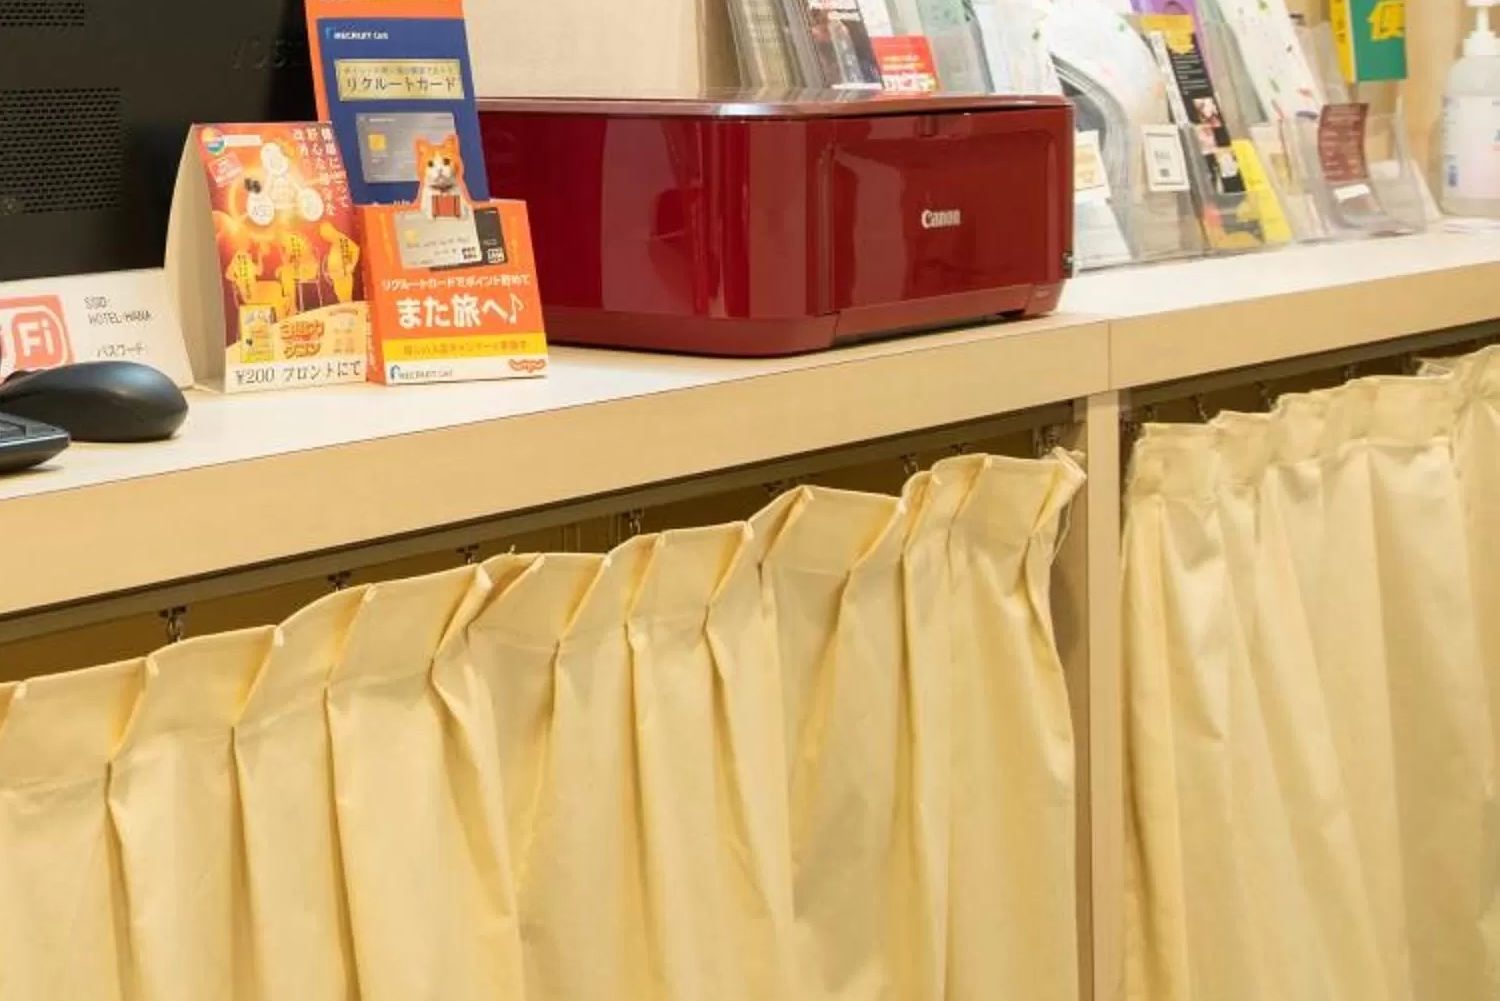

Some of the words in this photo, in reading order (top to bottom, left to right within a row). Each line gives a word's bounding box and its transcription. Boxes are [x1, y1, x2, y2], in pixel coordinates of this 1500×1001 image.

[346, 76, 458, 93] リクルートカード
[921, 208, 962, 230] Canon
[282, 359, 361, 382] フロントにて
